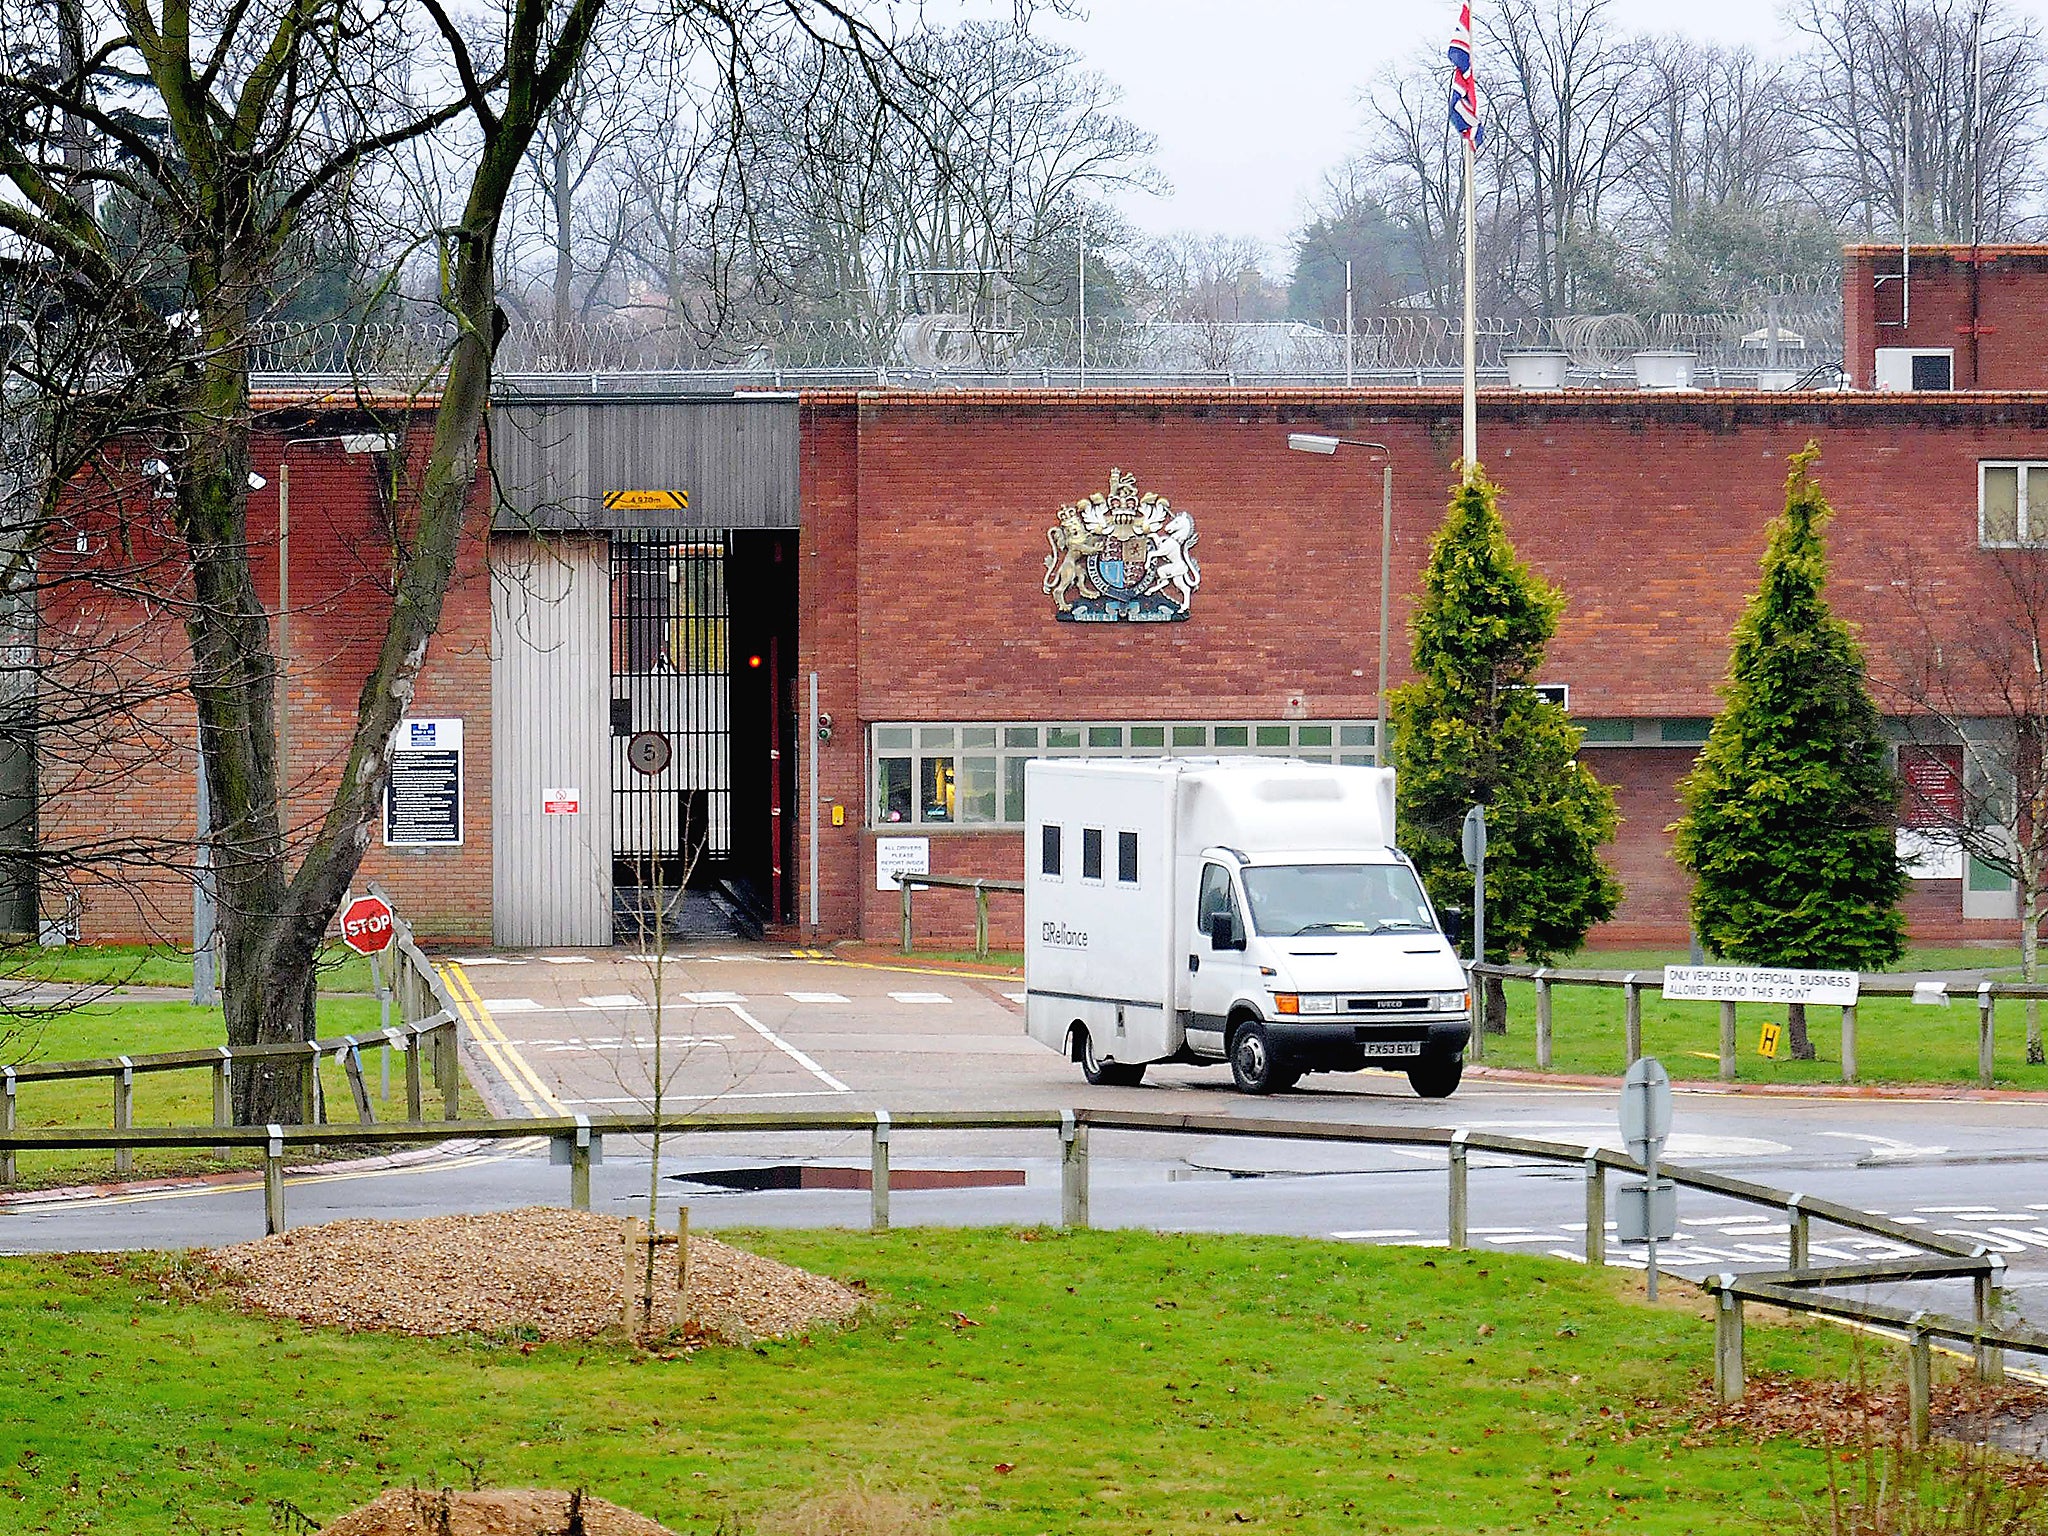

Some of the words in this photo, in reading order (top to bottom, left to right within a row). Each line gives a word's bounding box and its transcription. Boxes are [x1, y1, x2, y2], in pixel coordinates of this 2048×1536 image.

[643, 743, 655, 761] 5
[346, 914, 390, 937] STOP
[1050, 921, 1088, 947] Reliance
[1669, 970, 1690, 981] ONLY
[1692, 971, 1731, 982] VEHICLES
[1735, 972, 1748, 983] ON
[1751, 972, 1794, 985] OFFICIAL
[1800, 974, 1851, 988] BUSINESS
[1669, 984, 1708, 995] ALLOWED
[1712, 985, 1747, 997] BEYOND
[1751, 986, 1774, 998] THIS
[1780, 988, 1811, 999] POINT
[1377, 1000, 1403, 1008] IVECO
[1762, 1027, 1777, 1052] H
[1368, 1044, 1396, 1055] FX53
[1397, 1043, 1416, 1054] EYL
